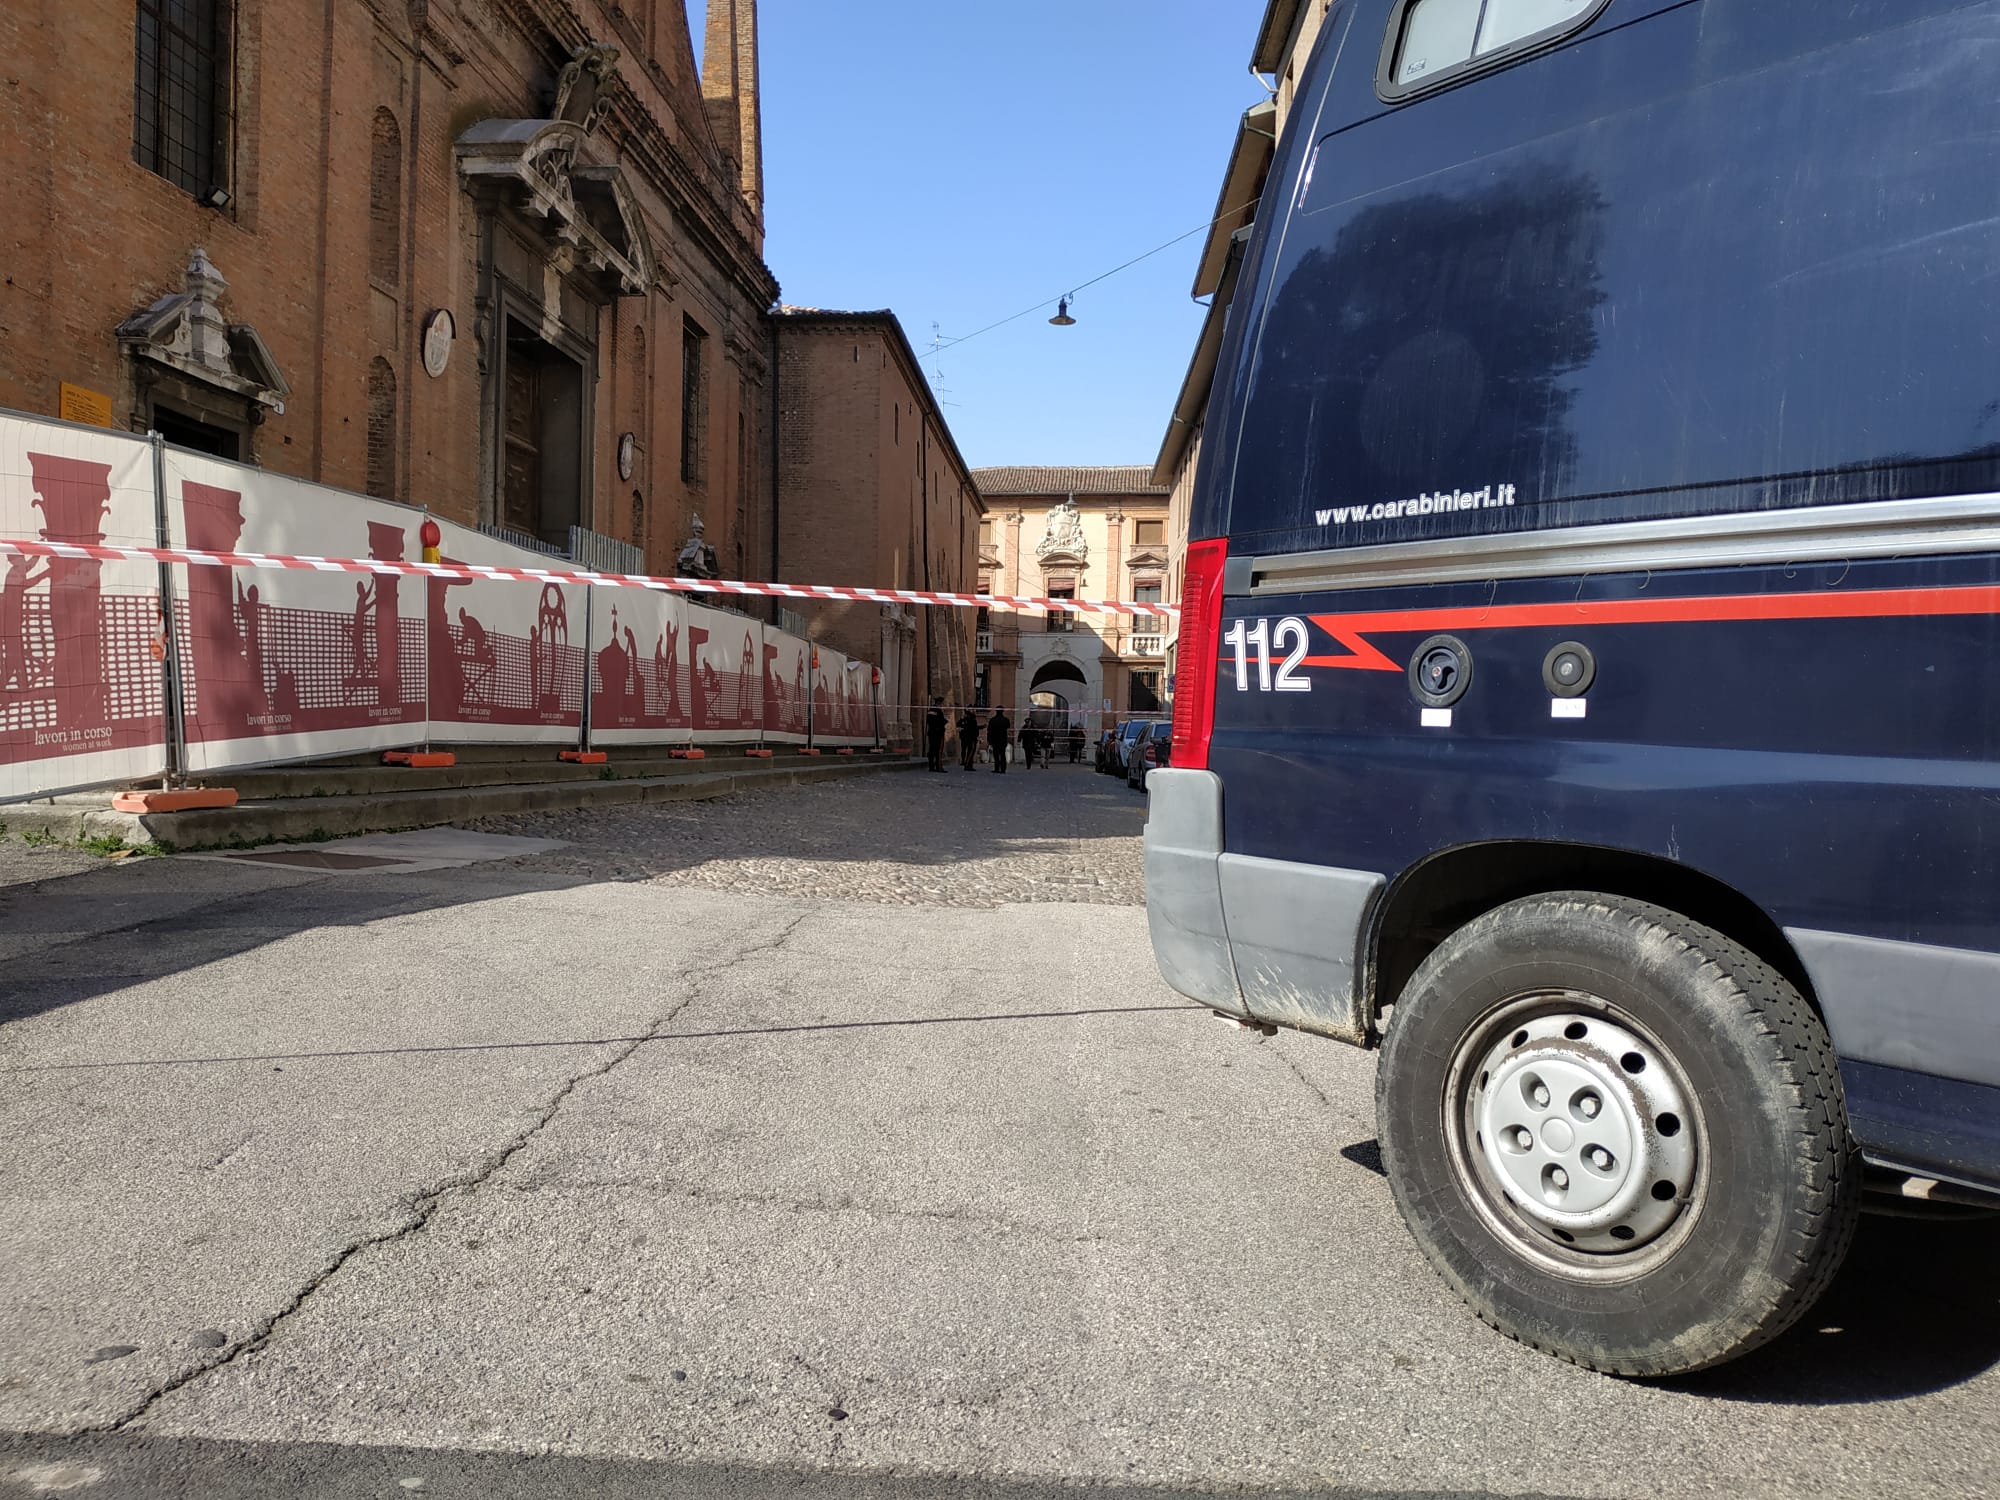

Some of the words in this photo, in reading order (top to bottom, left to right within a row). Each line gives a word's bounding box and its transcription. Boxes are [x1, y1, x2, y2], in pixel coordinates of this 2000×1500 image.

[1315, 483, 1515, 525] www.carabinieri.it
[1225, 616, 1311, 691] 112
[246, 712, 266, 725] lavori
[267, 711, 274, 724] in
[274, 714, 291, 723] corso
[35, 727, 67, 745] lavori
[70, 726, 81, 741] in
[84, 727, 112, 739] corso
[63, 742, 87, 752] women
[88, 740, 95, 748] at
[96, 738, 112, 747] work
